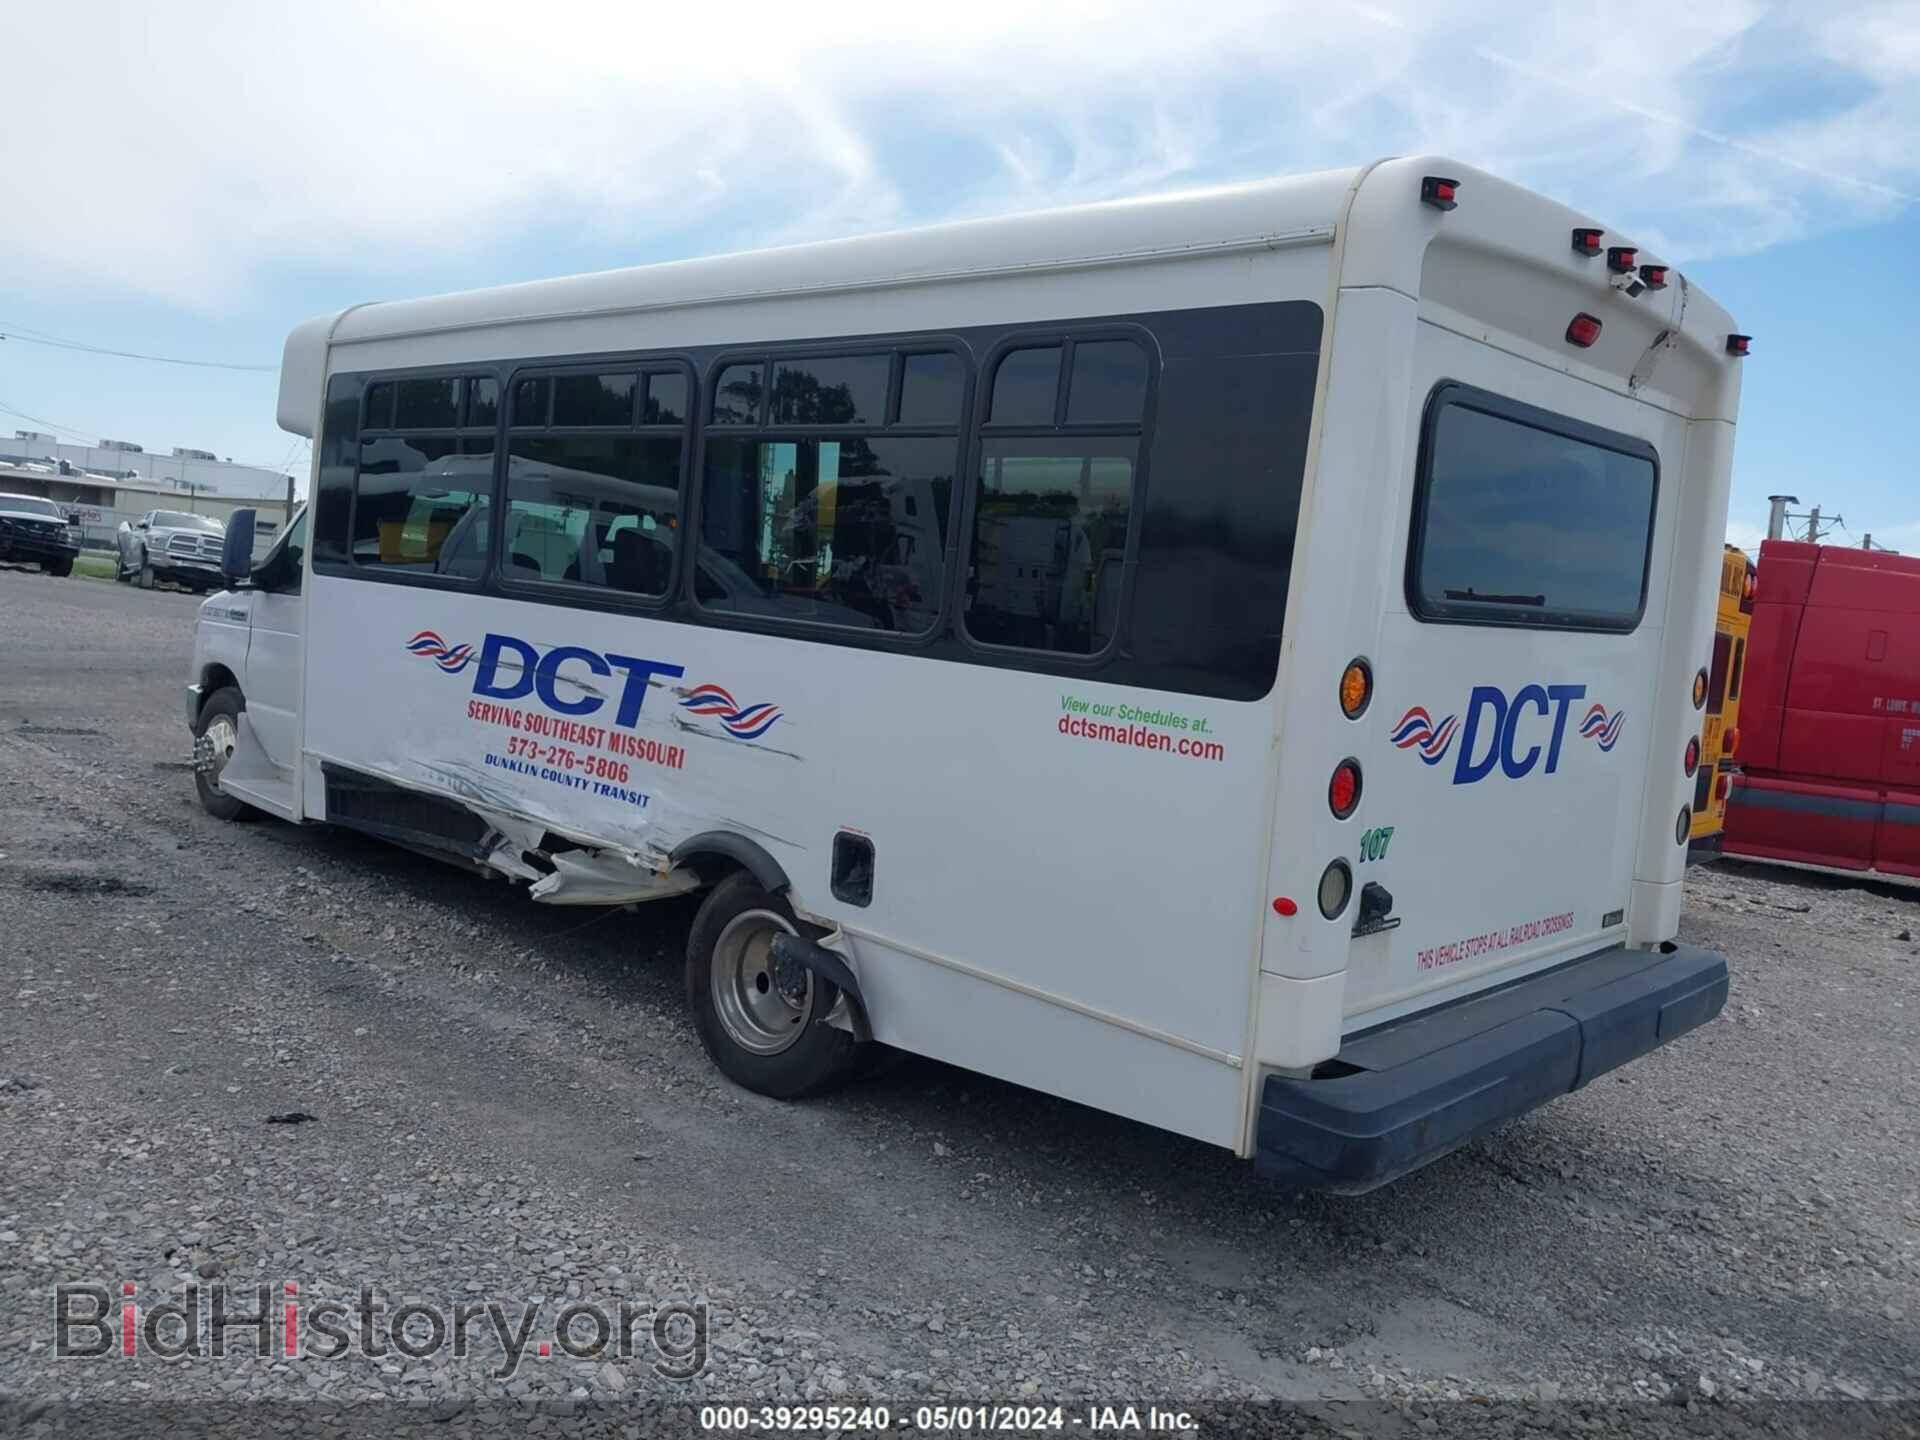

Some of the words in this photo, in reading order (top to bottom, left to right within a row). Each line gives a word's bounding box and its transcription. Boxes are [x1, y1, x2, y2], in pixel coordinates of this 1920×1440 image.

[472, 632, 686, 729] DCT
[467, 700, 522, 729] SERVING
[524, 714, 606, 748] SOUTHEAST
[608, 732, 685, 769] MISSOURI
[1058, 714, 1225, 762] dctsmalden.com
[1061, 695, 1090, 713] View
[1092, 702, 1115, 717] our
[1118, 703, 1188, 729] Schedules
[1453, 684, 1587, 785] DCT
[485, 753, 538, 777] DUNKLIN
[541, 768, 590, 791] COUNTY
[593, 782, 651, 809] TRANSIT
[507, 736, 630, 784] 573-276-5806
[1359, 826, 1395, 863] 107
[1417, 949, 1434, 970] THIS
[1435, 940, 1465, 967] VEHICLE
[1465, 934, 1488, 959] STOPS
[1487, 931, 1498, 951] AT
[1497, 927, 1509, 949] ALL
[1509, 919, 1541, 945] RAILROAD
[1541, 911, 1575, 937] CROSSINGS
